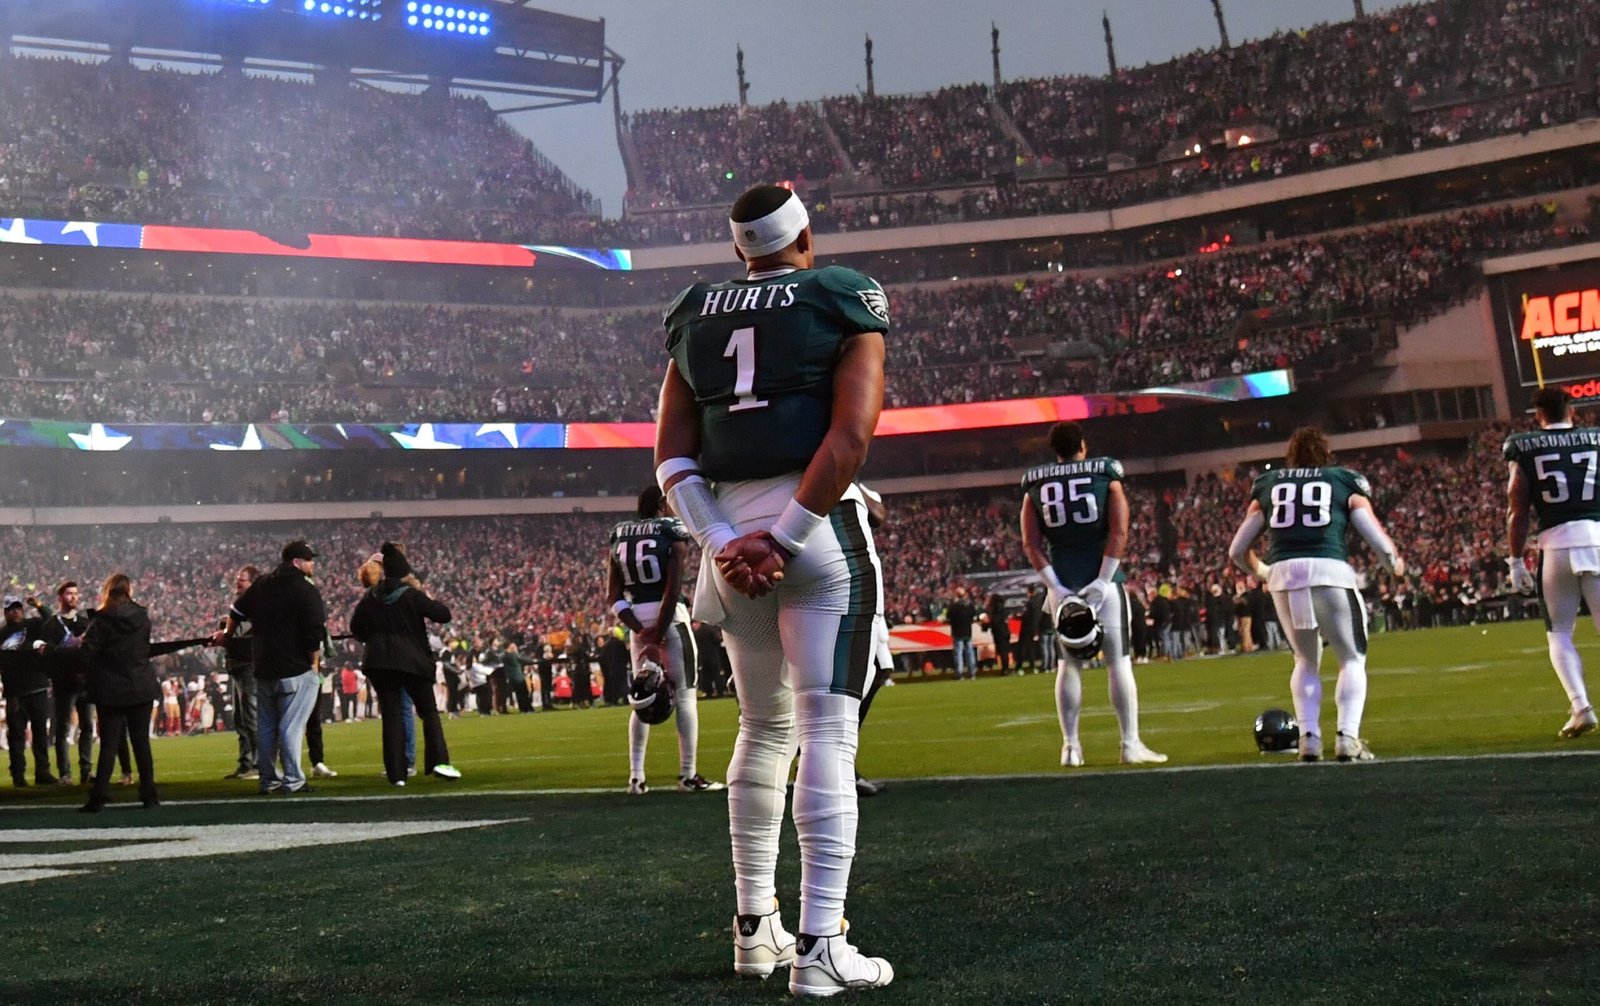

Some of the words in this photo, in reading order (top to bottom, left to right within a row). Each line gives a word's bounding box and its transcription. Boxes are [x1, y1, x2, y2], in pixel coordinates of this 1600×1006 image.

[700, 283, 798, 317] HURTS
[723, 327, 769, 413] 1
[1278, 468, 1322, 479] STOLL
[1534, 450, 1598, 504] 57
[1040, 477, 1098, 528] 85
[1270, 481, 1332, 529] 89
[616, 539, 662, 586] 16
